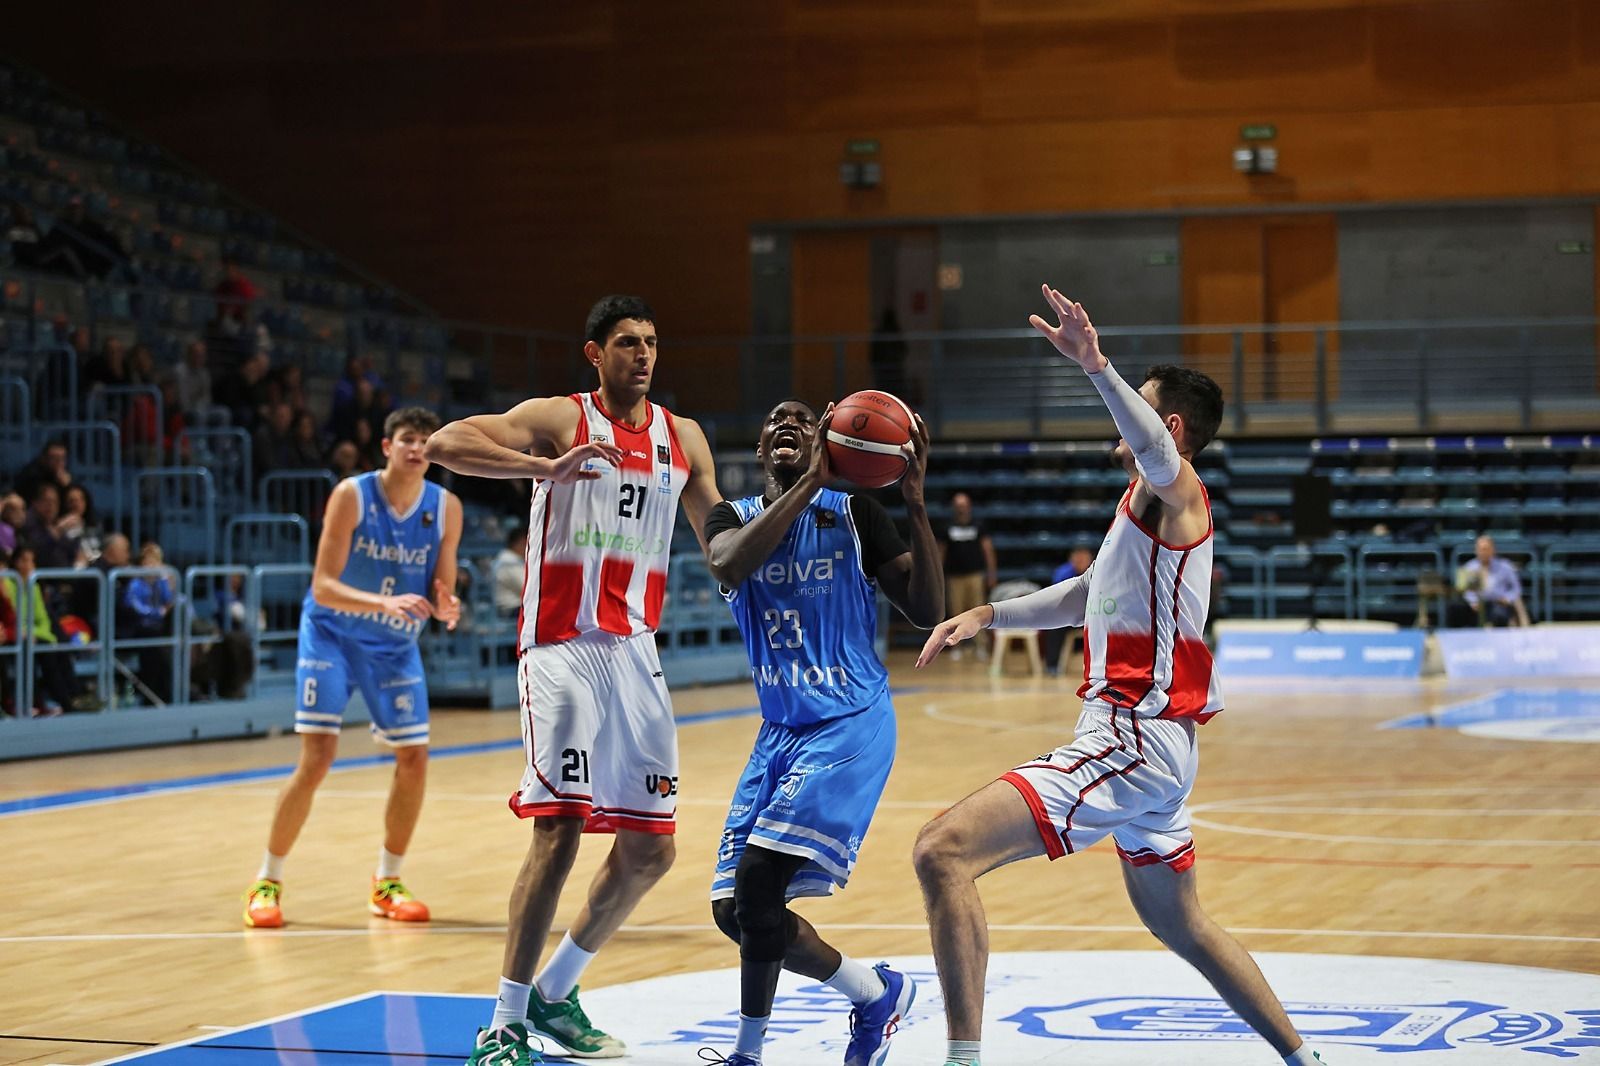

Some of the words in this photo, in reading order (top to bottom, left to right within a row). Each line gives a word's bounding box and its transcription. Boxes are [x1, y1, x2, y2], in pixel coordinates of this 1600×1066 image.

[618, 483, 648, 520] 21
[354, 536, 427, 565] Huelva
[752, 555, 833, 585] elva
[793, 583, 833, 598] original
[764, 608, 803, 649] 23
[303, 677, 318, 708] 6
[561, 748, 590, 784] 21
